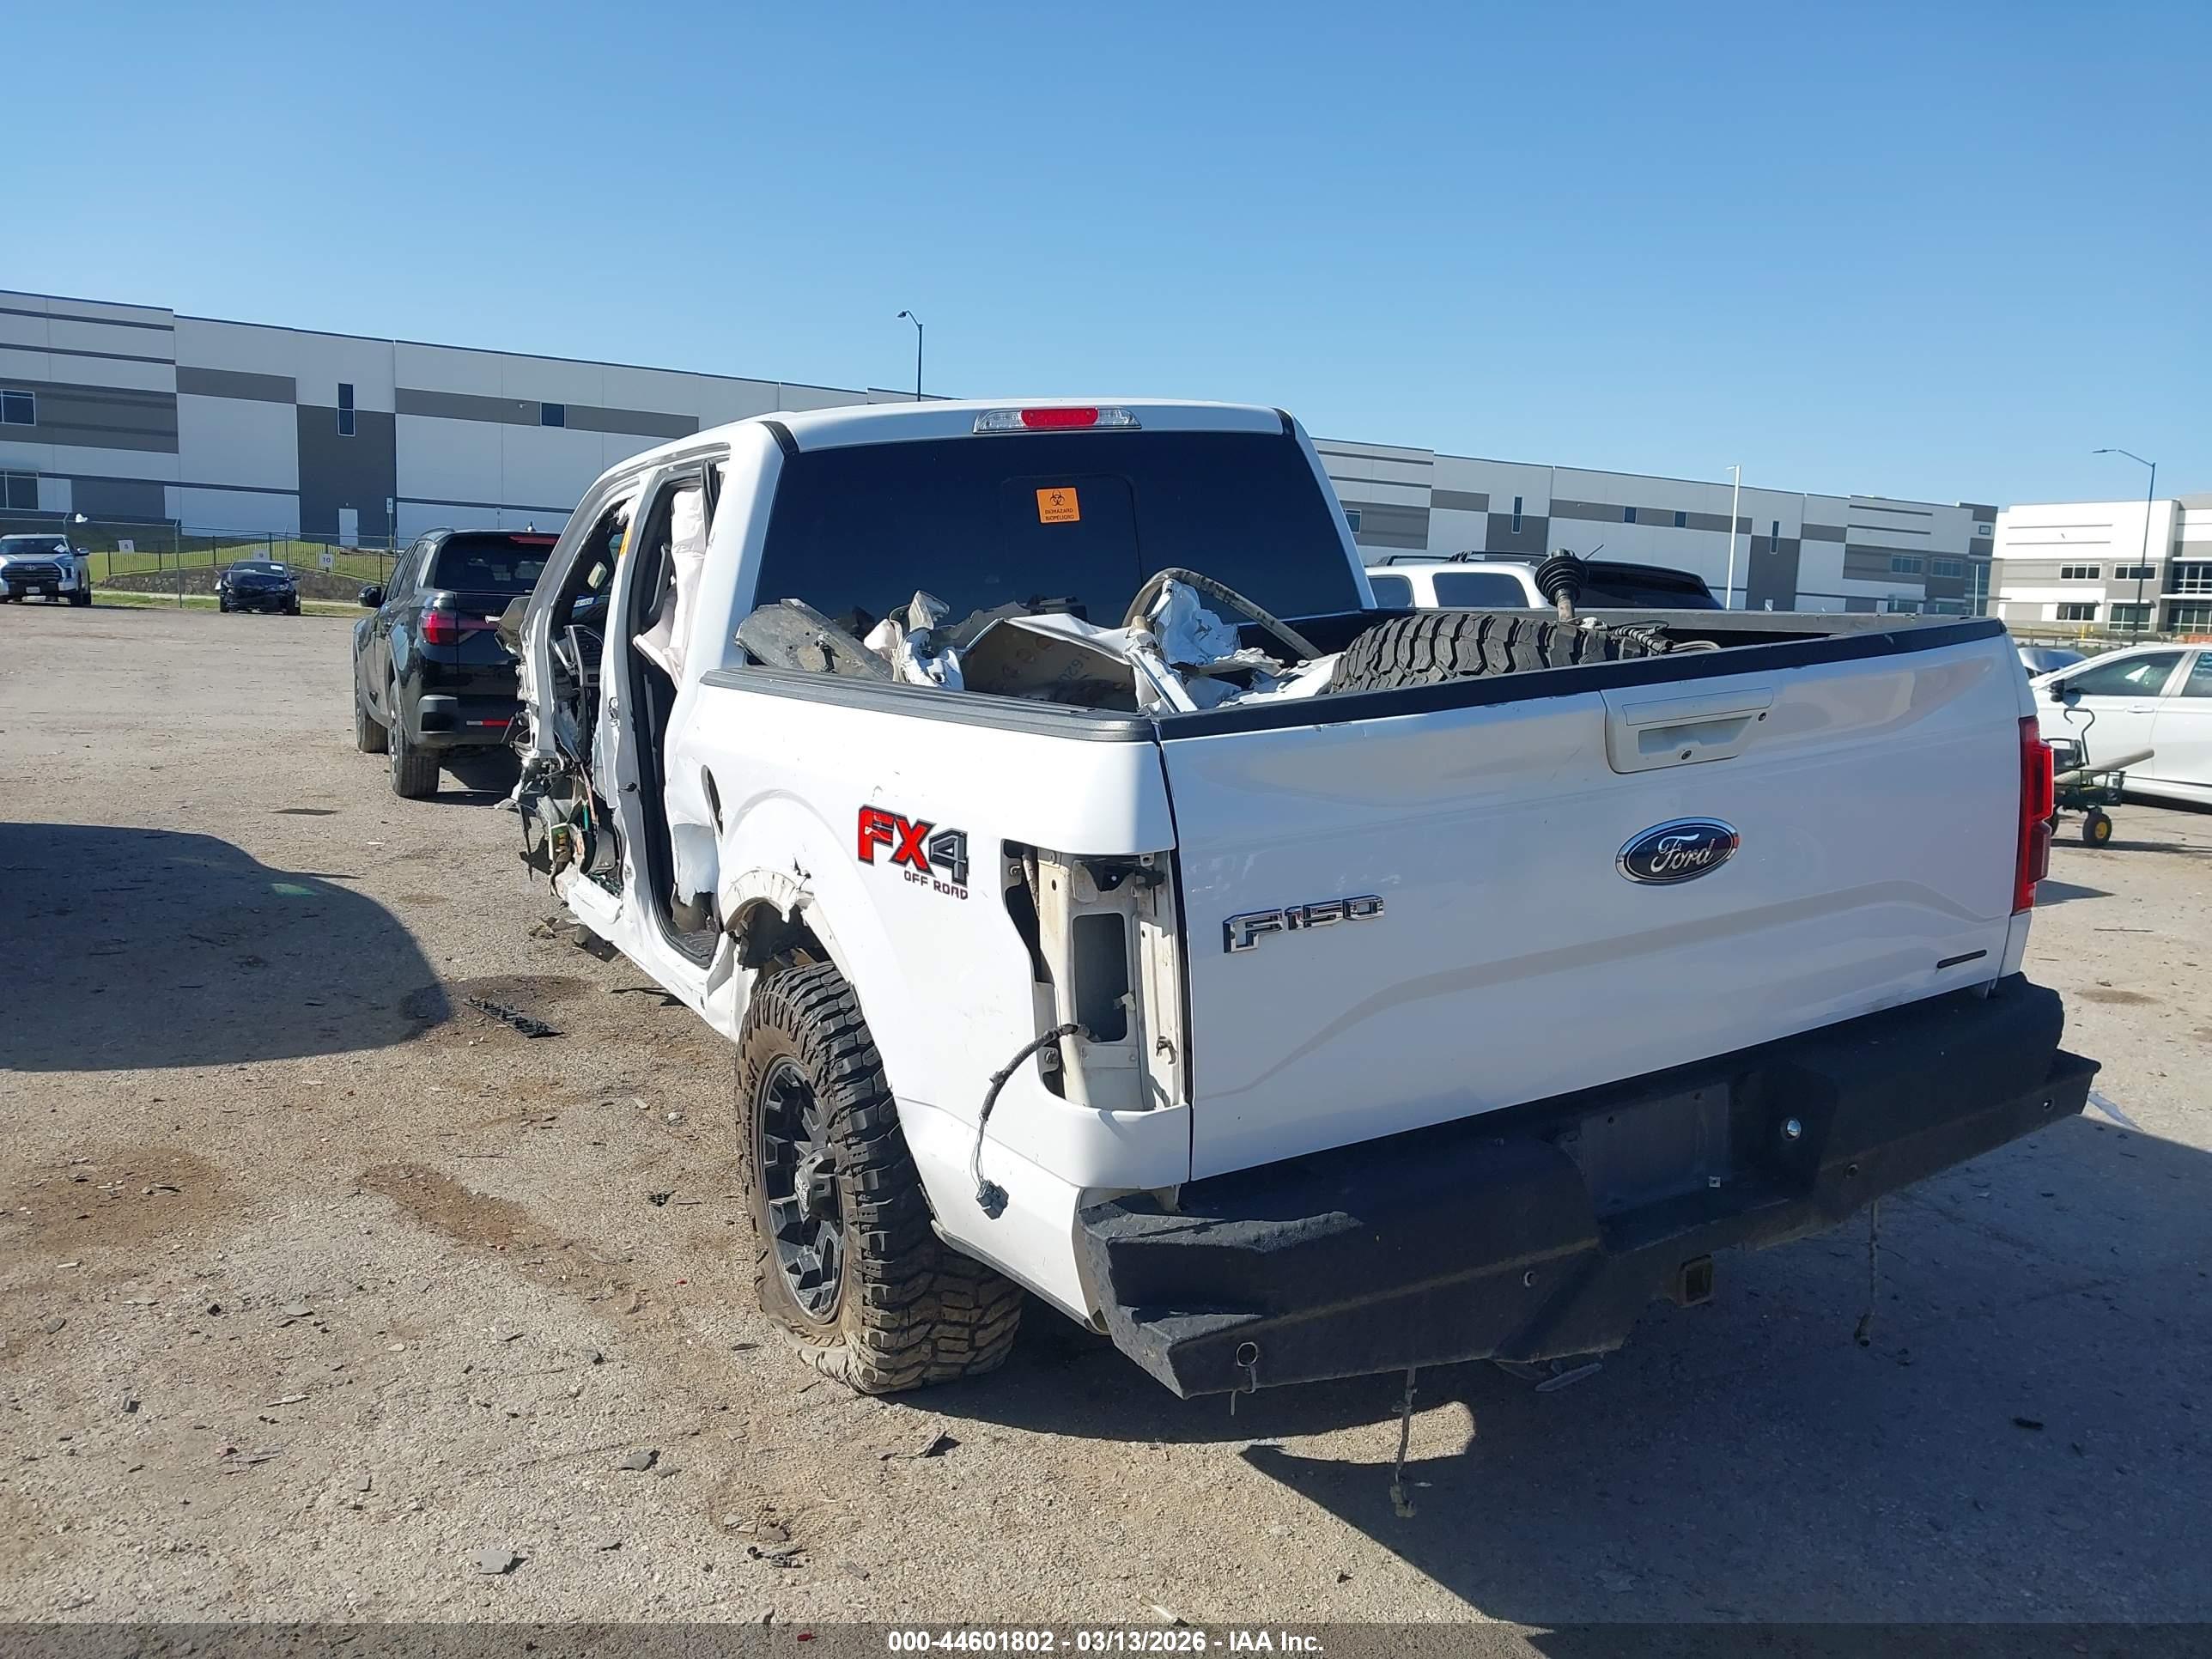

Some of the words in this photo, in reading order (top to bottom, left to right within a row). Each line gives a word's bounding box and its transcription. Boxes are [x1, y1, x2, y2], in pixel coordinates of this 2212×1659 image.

[857, 804, 969, 888] FX4
[1650, 832, 1717, 873] Ford
[904, 870, 928, 886] OFF
[933, 879, 969, 900] ROAD
[1223, 894, 1385, 953] F150
